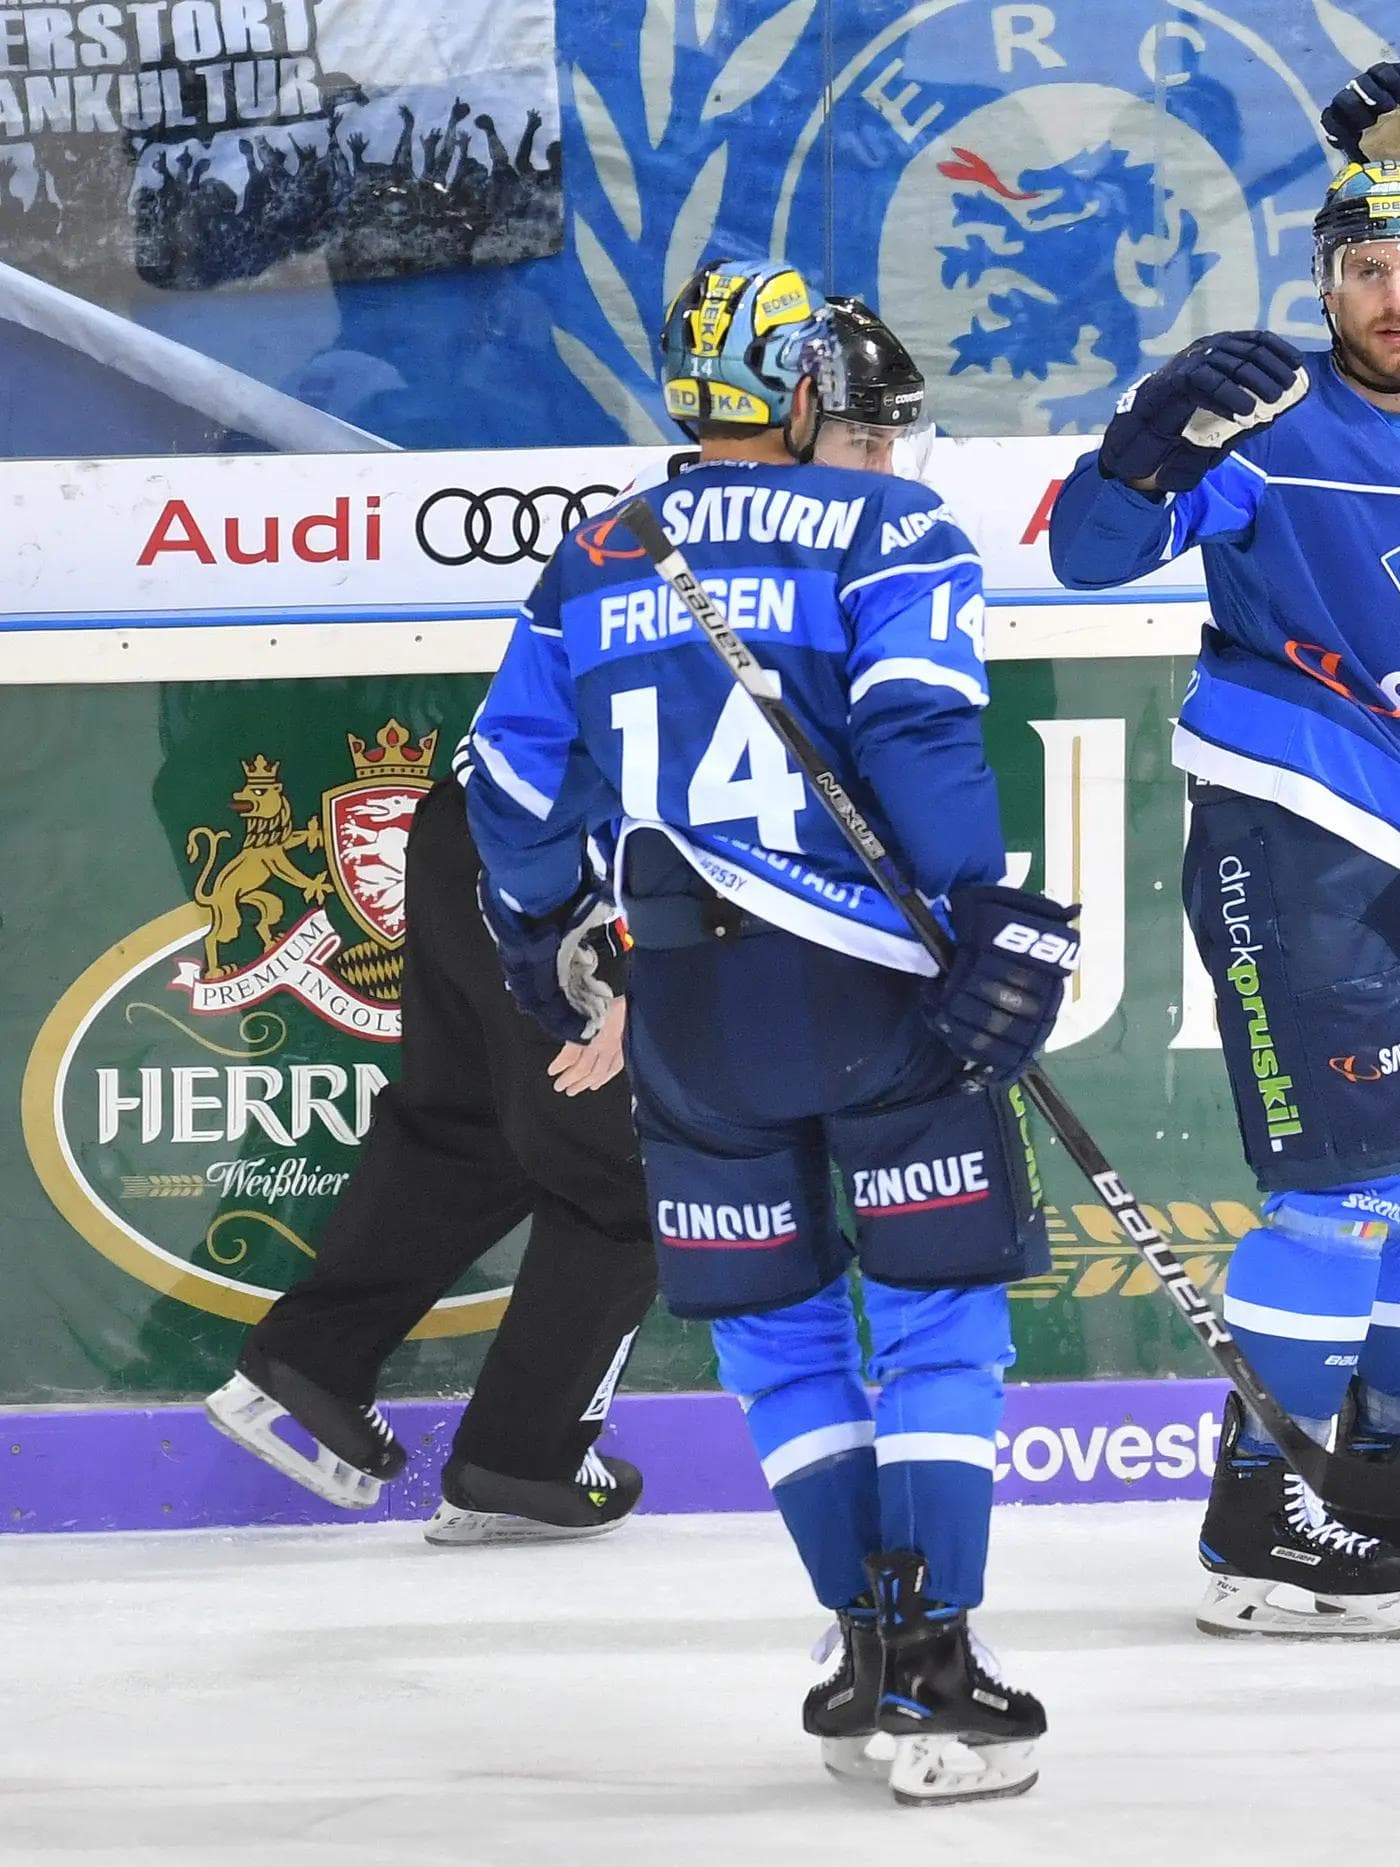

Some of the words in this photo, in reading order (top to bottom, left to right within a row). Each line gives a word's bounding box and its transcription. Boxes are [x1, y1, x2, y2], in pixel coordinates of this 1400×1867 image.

[690, 357, 712, 377] 14
[136, 496, 381, 566] Audi
[662, 485, 865, 551] SATURN
[673, 572, 751, 669] BAUER
[930, 580, 986, 664] 14
[610, 669, 806, 855] 14
[201, 921, 325, 1007] PREMIUM
[206, 1157, 350, 1205] Weißbier
[853, 1151, 990, 1208] CINQUE
[657, 1199, 797, 1241] CINQUE
[1092, 1171, 1233, 1348] BAUER
